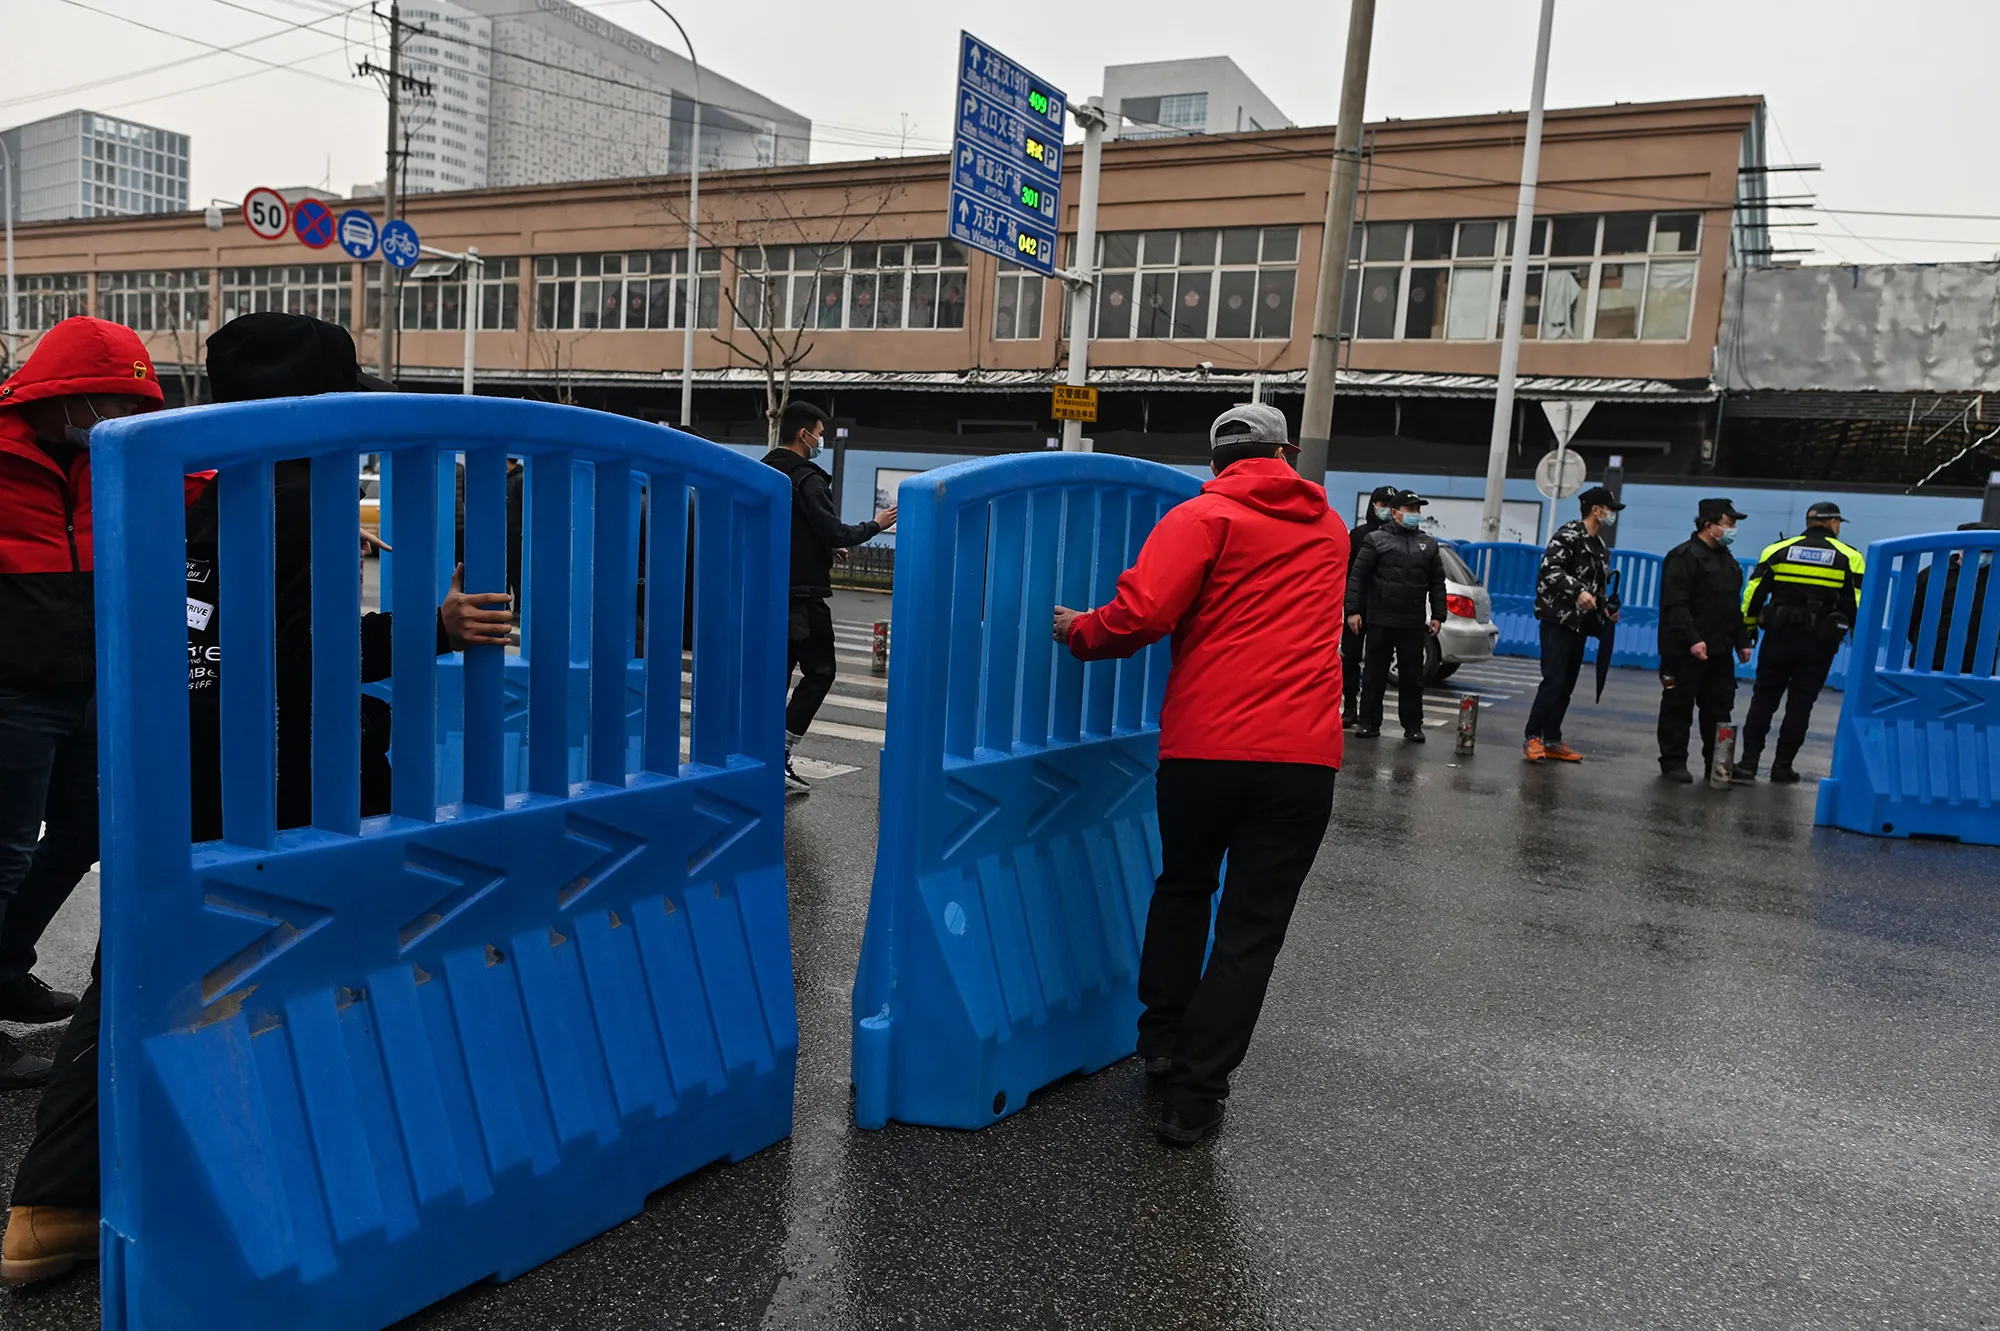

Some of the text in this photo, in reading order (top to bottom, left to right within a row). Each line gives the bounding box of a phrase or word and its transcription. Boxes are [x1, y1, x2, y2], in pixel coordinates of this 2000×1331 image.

[1028, 90, 1047, 114] 409
[980, 102, 1025, 147] 汉口火车站
[1021, 185, 1038, 209] 301
[253, 201, 281, 229] 50
[972, 204, 1017, 243] 万达广场
[1018, 233, 1036, 256] 042
[1802, 551, 1820, 559] POLICE
